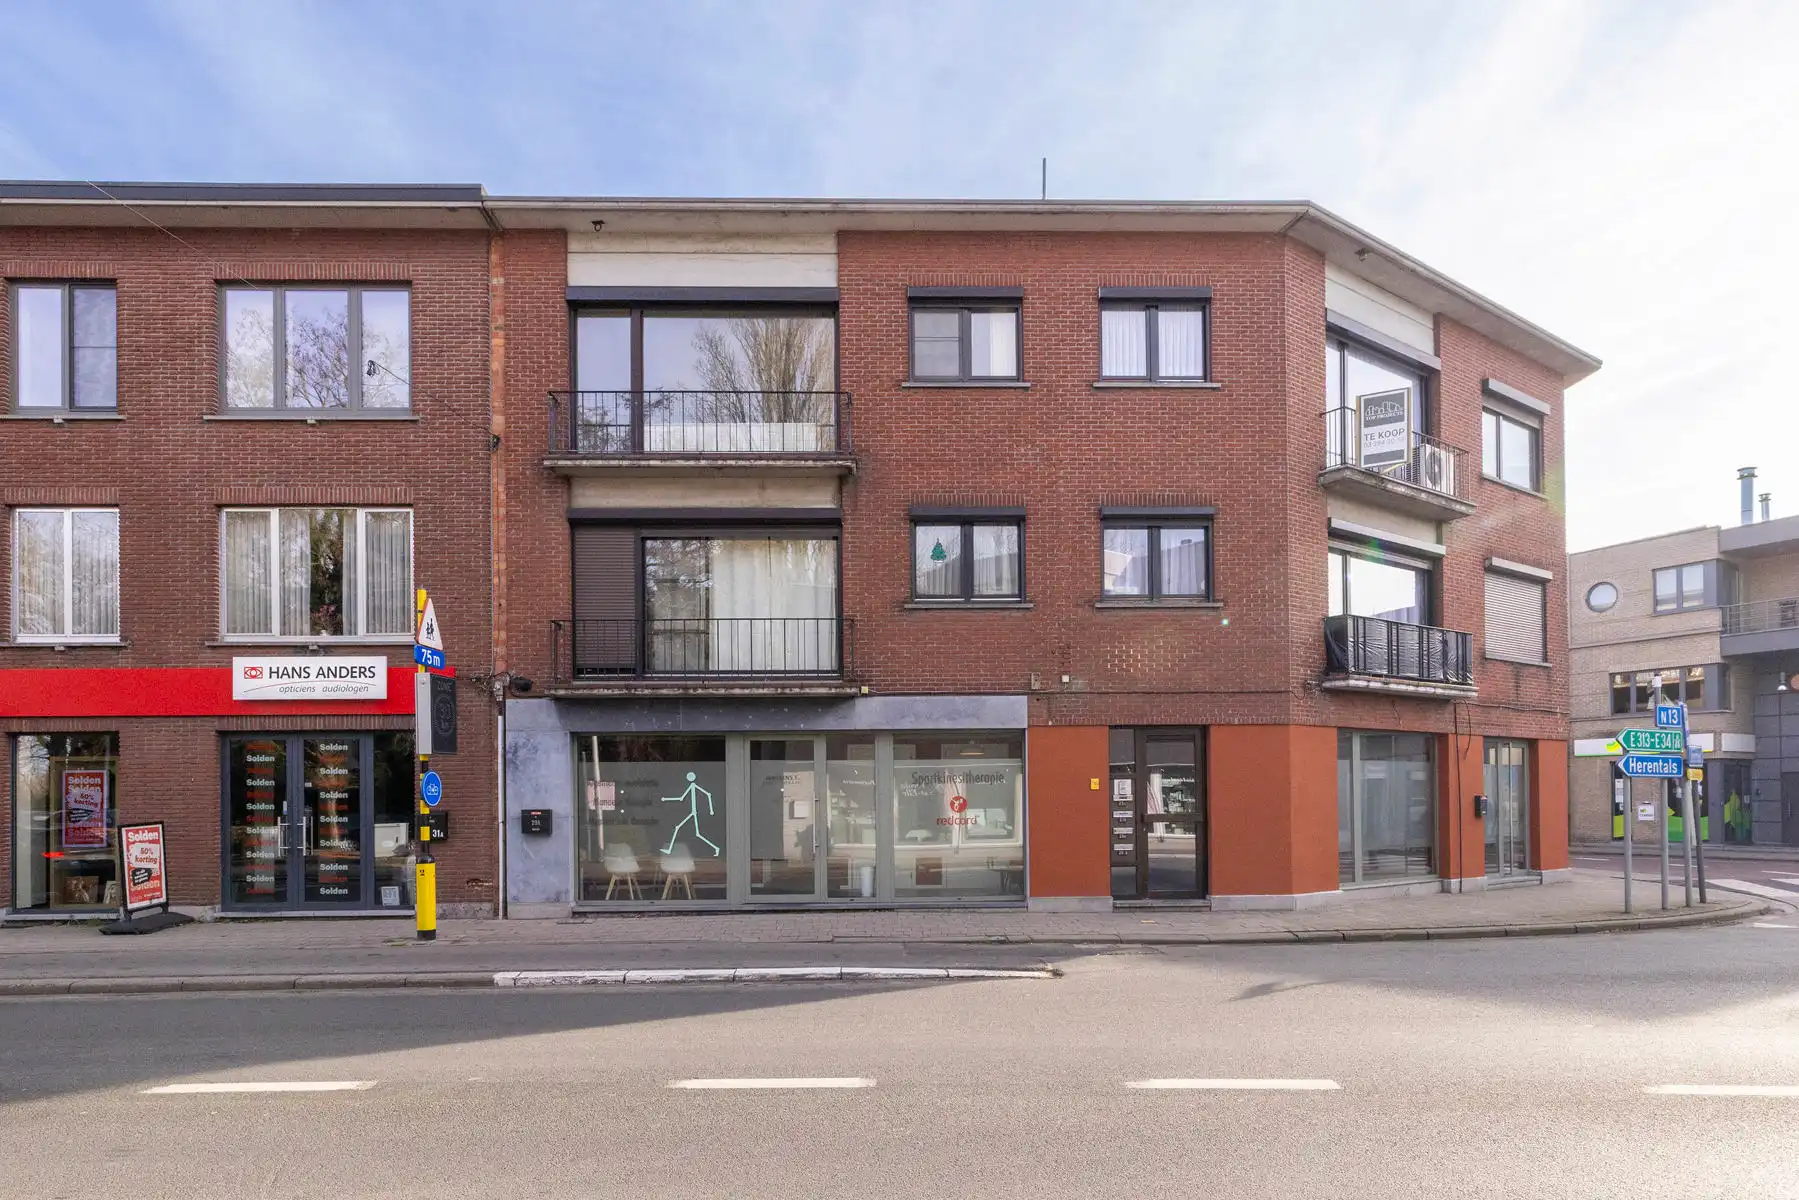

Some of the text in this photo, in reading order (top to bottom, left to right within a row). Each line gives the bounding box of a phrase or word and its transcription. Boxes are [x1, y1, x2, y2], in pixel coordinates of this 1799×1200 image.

[1364, 432, 1376, 441] TE
[1378, 428, 1405, 439] KOOP
[268, 665, 376, 679] HANS ANDERS
[279, 685, 369, 694] opticiens audiologen
[320, 743, 349, 751] Solden
[246, 754, 276, 762] Solden
[1629, 757, 1678, 773] Herentals
[320, 767, 349, 775] Solden
[68, 775, 101, 784] Solden
[246, 778, 276, 786] Solden
[320, 791, 349, 799] Solden
[246, 802, 276, 810] Solden
[320, 815, 349, 823] Solden
[128, 830, 159, 842] Solden
[320, 839, 349, 847] Solden
[246, 850, 276, 858] Solden
[134, 854, 158, 865] korting
[320, 863, 349, 871] Solden
[246, 874, 276, 882] Solden
[320, 887, 349, 895] Solden
